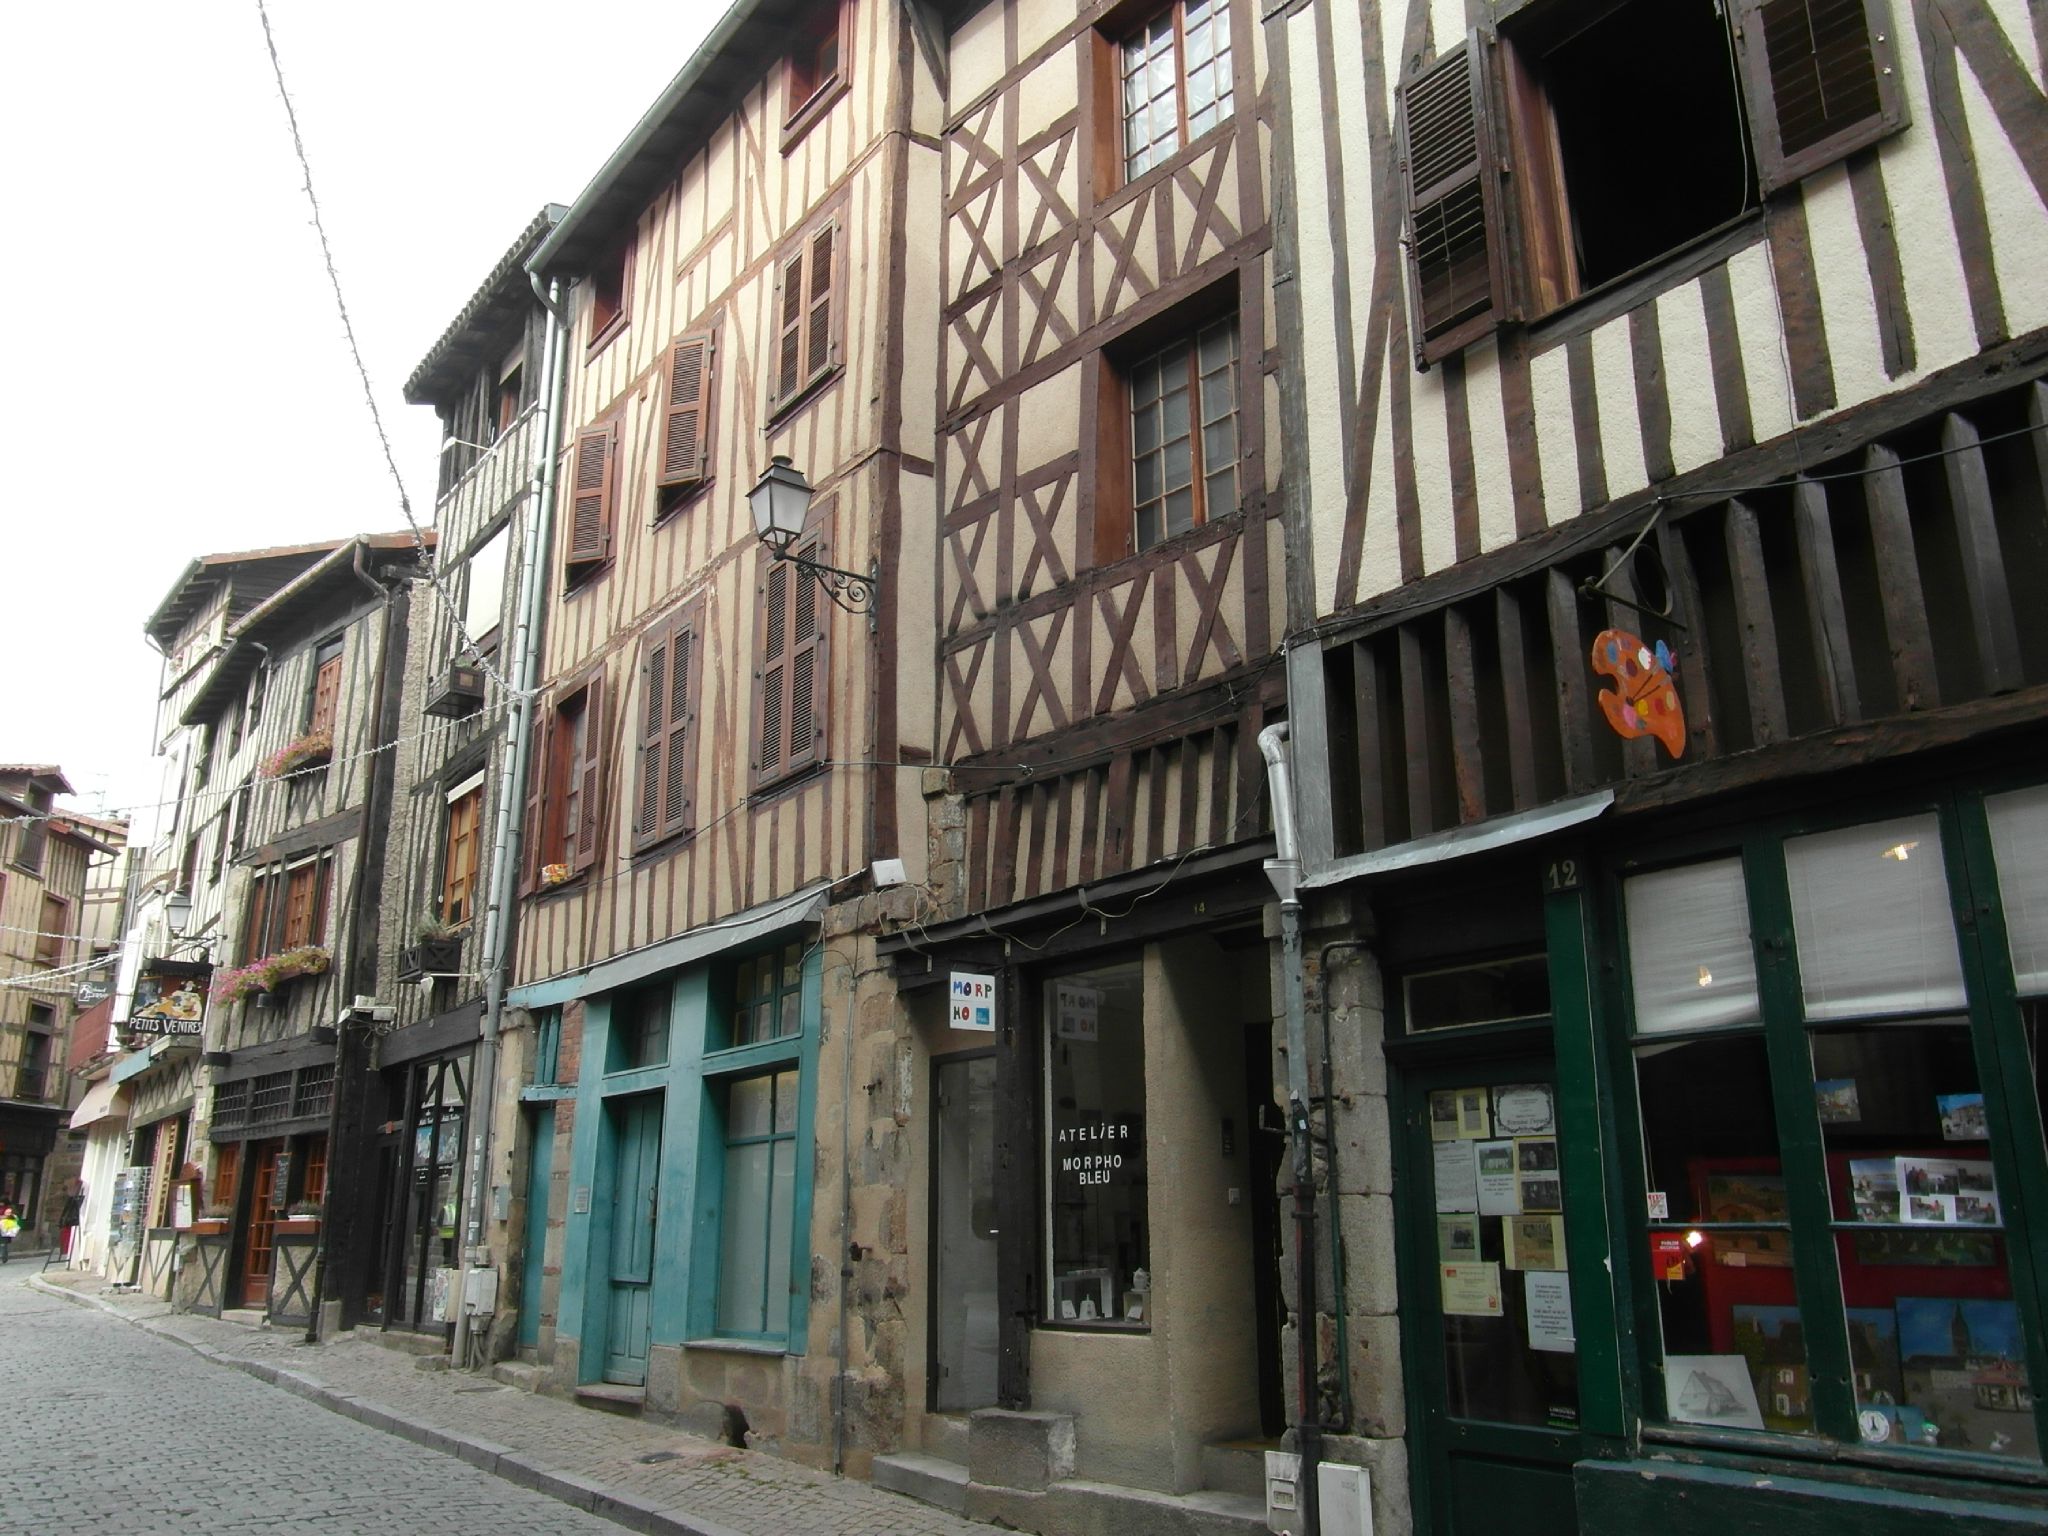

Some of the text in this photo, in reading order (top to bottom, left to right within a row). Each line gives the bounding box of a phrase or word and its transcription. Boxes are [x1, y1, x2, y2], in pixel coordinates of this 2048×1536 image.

[1549, 860, 1577, 889] 12
[953, 981, 992, 998] MORP
[953, 1006, 970, 1021] HO
[129, 1017, 203, 1034] PETITS VENTRES
[1063, 1154, 1122, 1171] MORPHO
[1079, 1169, 1111, 1185] BLEU
